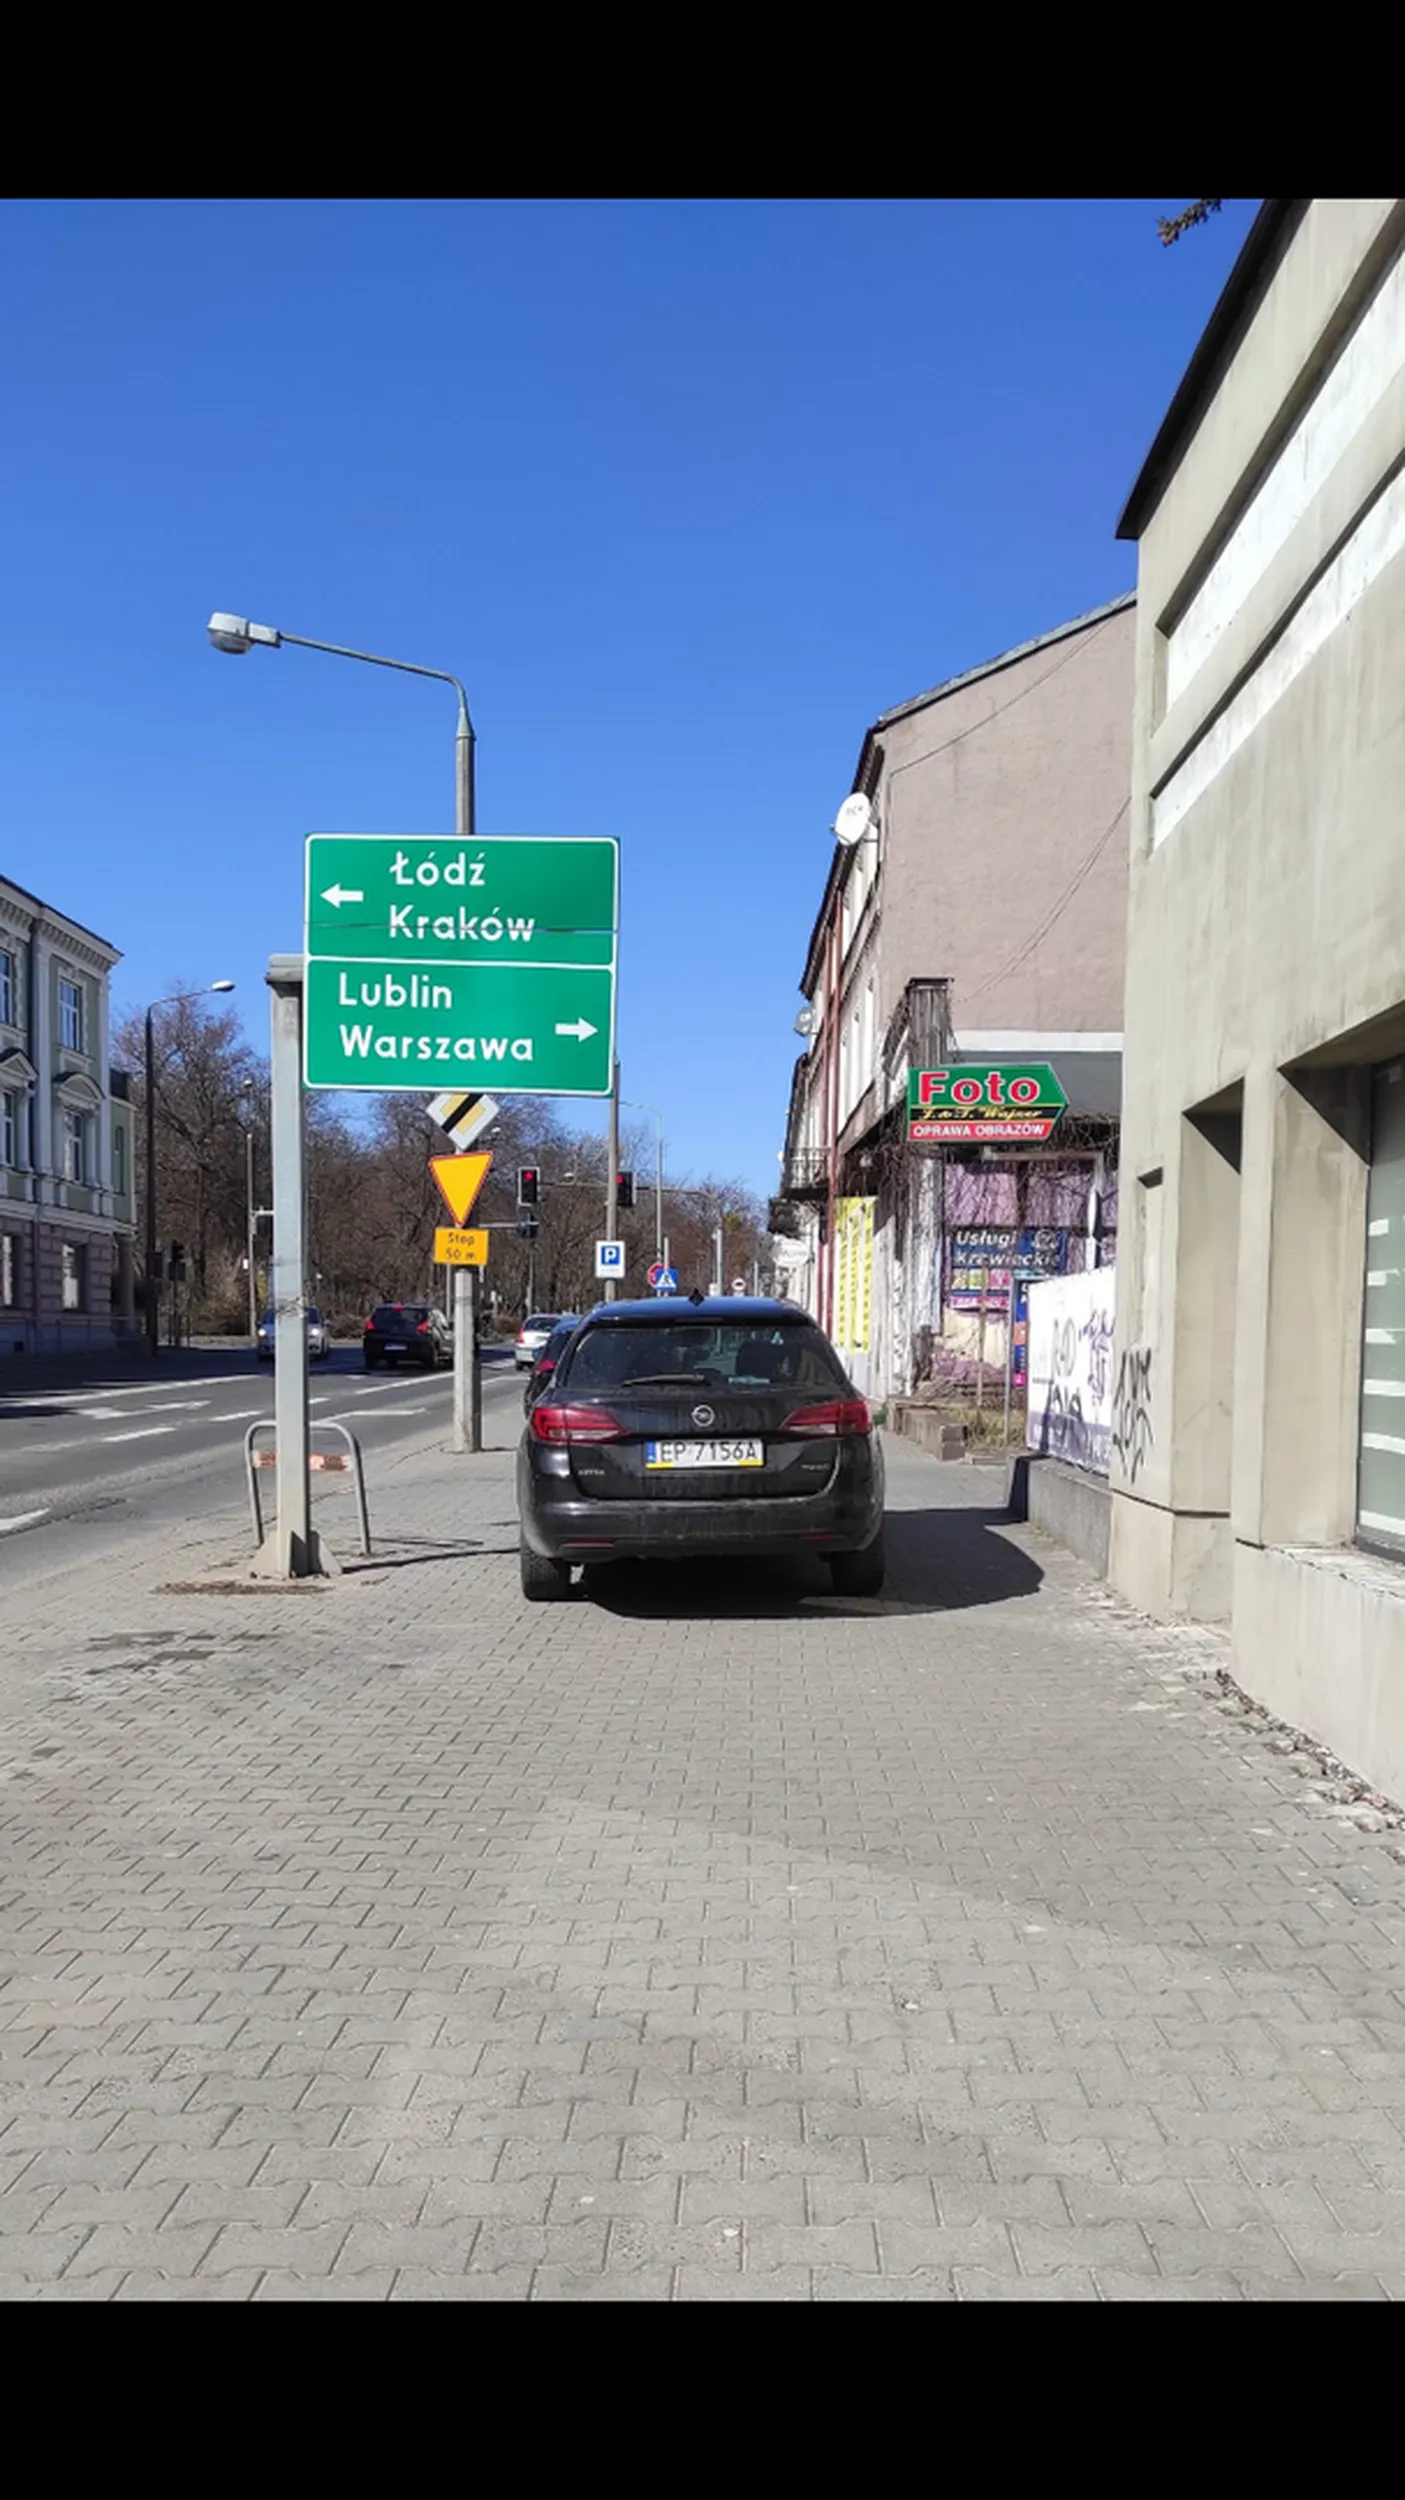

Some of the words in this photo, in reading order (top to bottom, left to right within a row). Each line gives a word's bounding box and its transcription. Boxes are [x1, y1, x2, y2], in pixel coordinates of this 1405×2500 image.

[389, 850, 486, 886] Łódź
[389, 904, 536, 942] Kraków
[339, 972, 452, 1009] Lublin
[339, 1024, 534, 1061] Warszawa
[919, 1070, 1041, 1105] Foto
[913, 1124, 971, 1137] OPRAWA
[975, 1122, 1044, 1137] OBRAZÓW
[448, 1232, 475, 1246] Stop
[446, 1247, 461, 1260] 50
[465, 1251, 476, 1260] m
[605, 1247, 618, 1264] P
[661, 1441, 686, 1462] EP
[694, 1440, 757, 1461] 7156A
